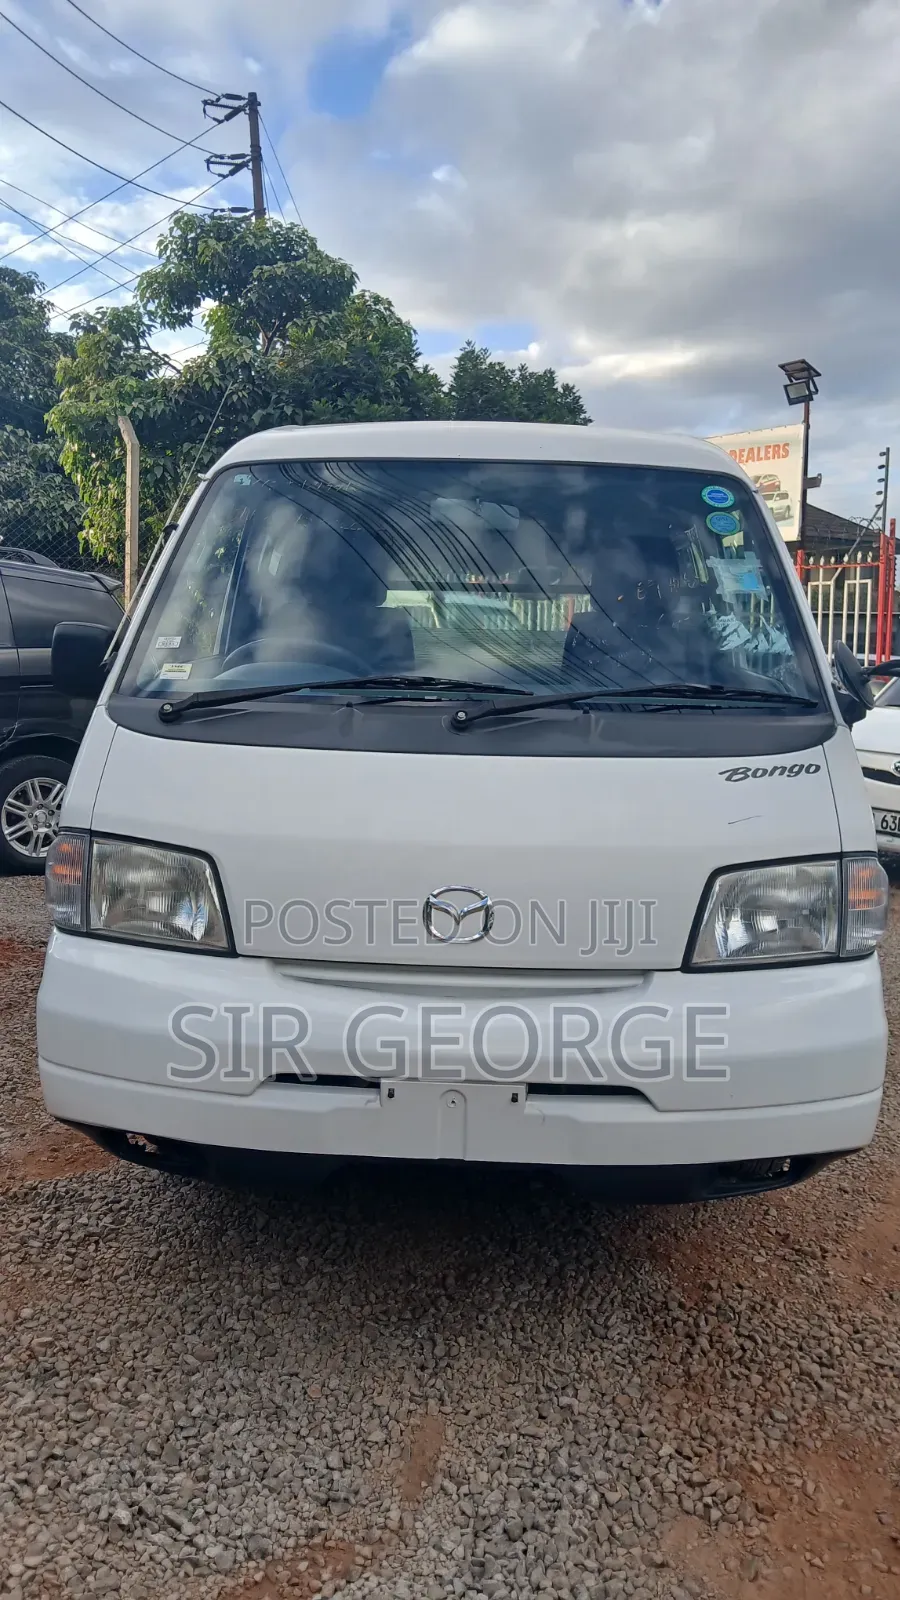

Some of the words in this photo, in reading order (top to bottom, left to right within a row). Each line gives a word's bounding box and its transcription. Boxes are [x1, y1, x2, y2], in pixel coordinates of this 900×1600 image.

[728, 442, 790, 464] DEALERS
[718, 763, 821, 782] Bongo
[880, 814, 900, 832] 63
